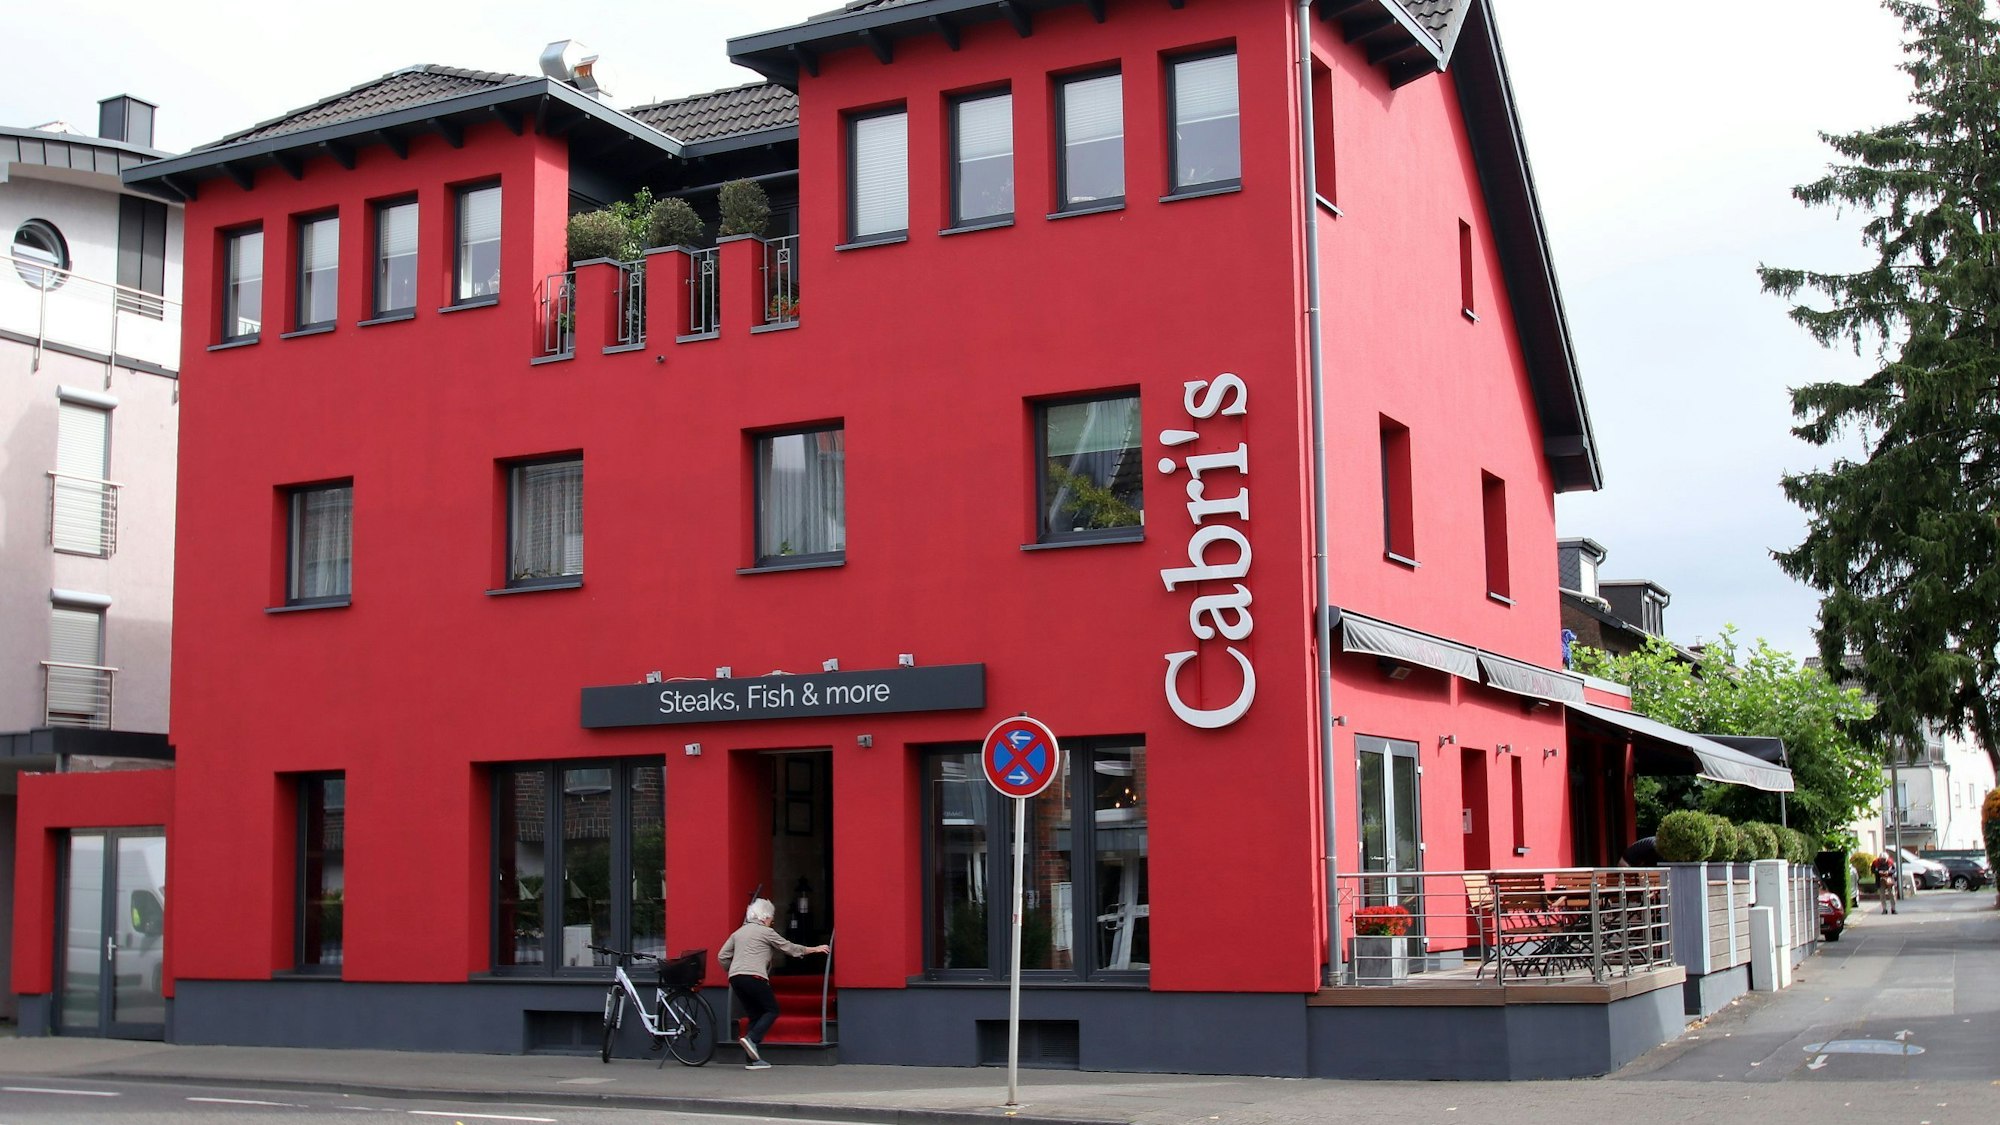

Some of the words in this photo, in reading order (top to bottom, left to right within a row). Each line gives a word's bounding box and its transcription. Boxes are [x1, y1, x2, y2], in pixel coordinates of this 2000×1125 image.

[1157, 372, 1257, 729] Cabri's
[659, 687, 740, 713] Steaks,
[747, 683, 795, 709] Fish
[801, 682, 820, 706] &
[826, 680, 891, 704] more
